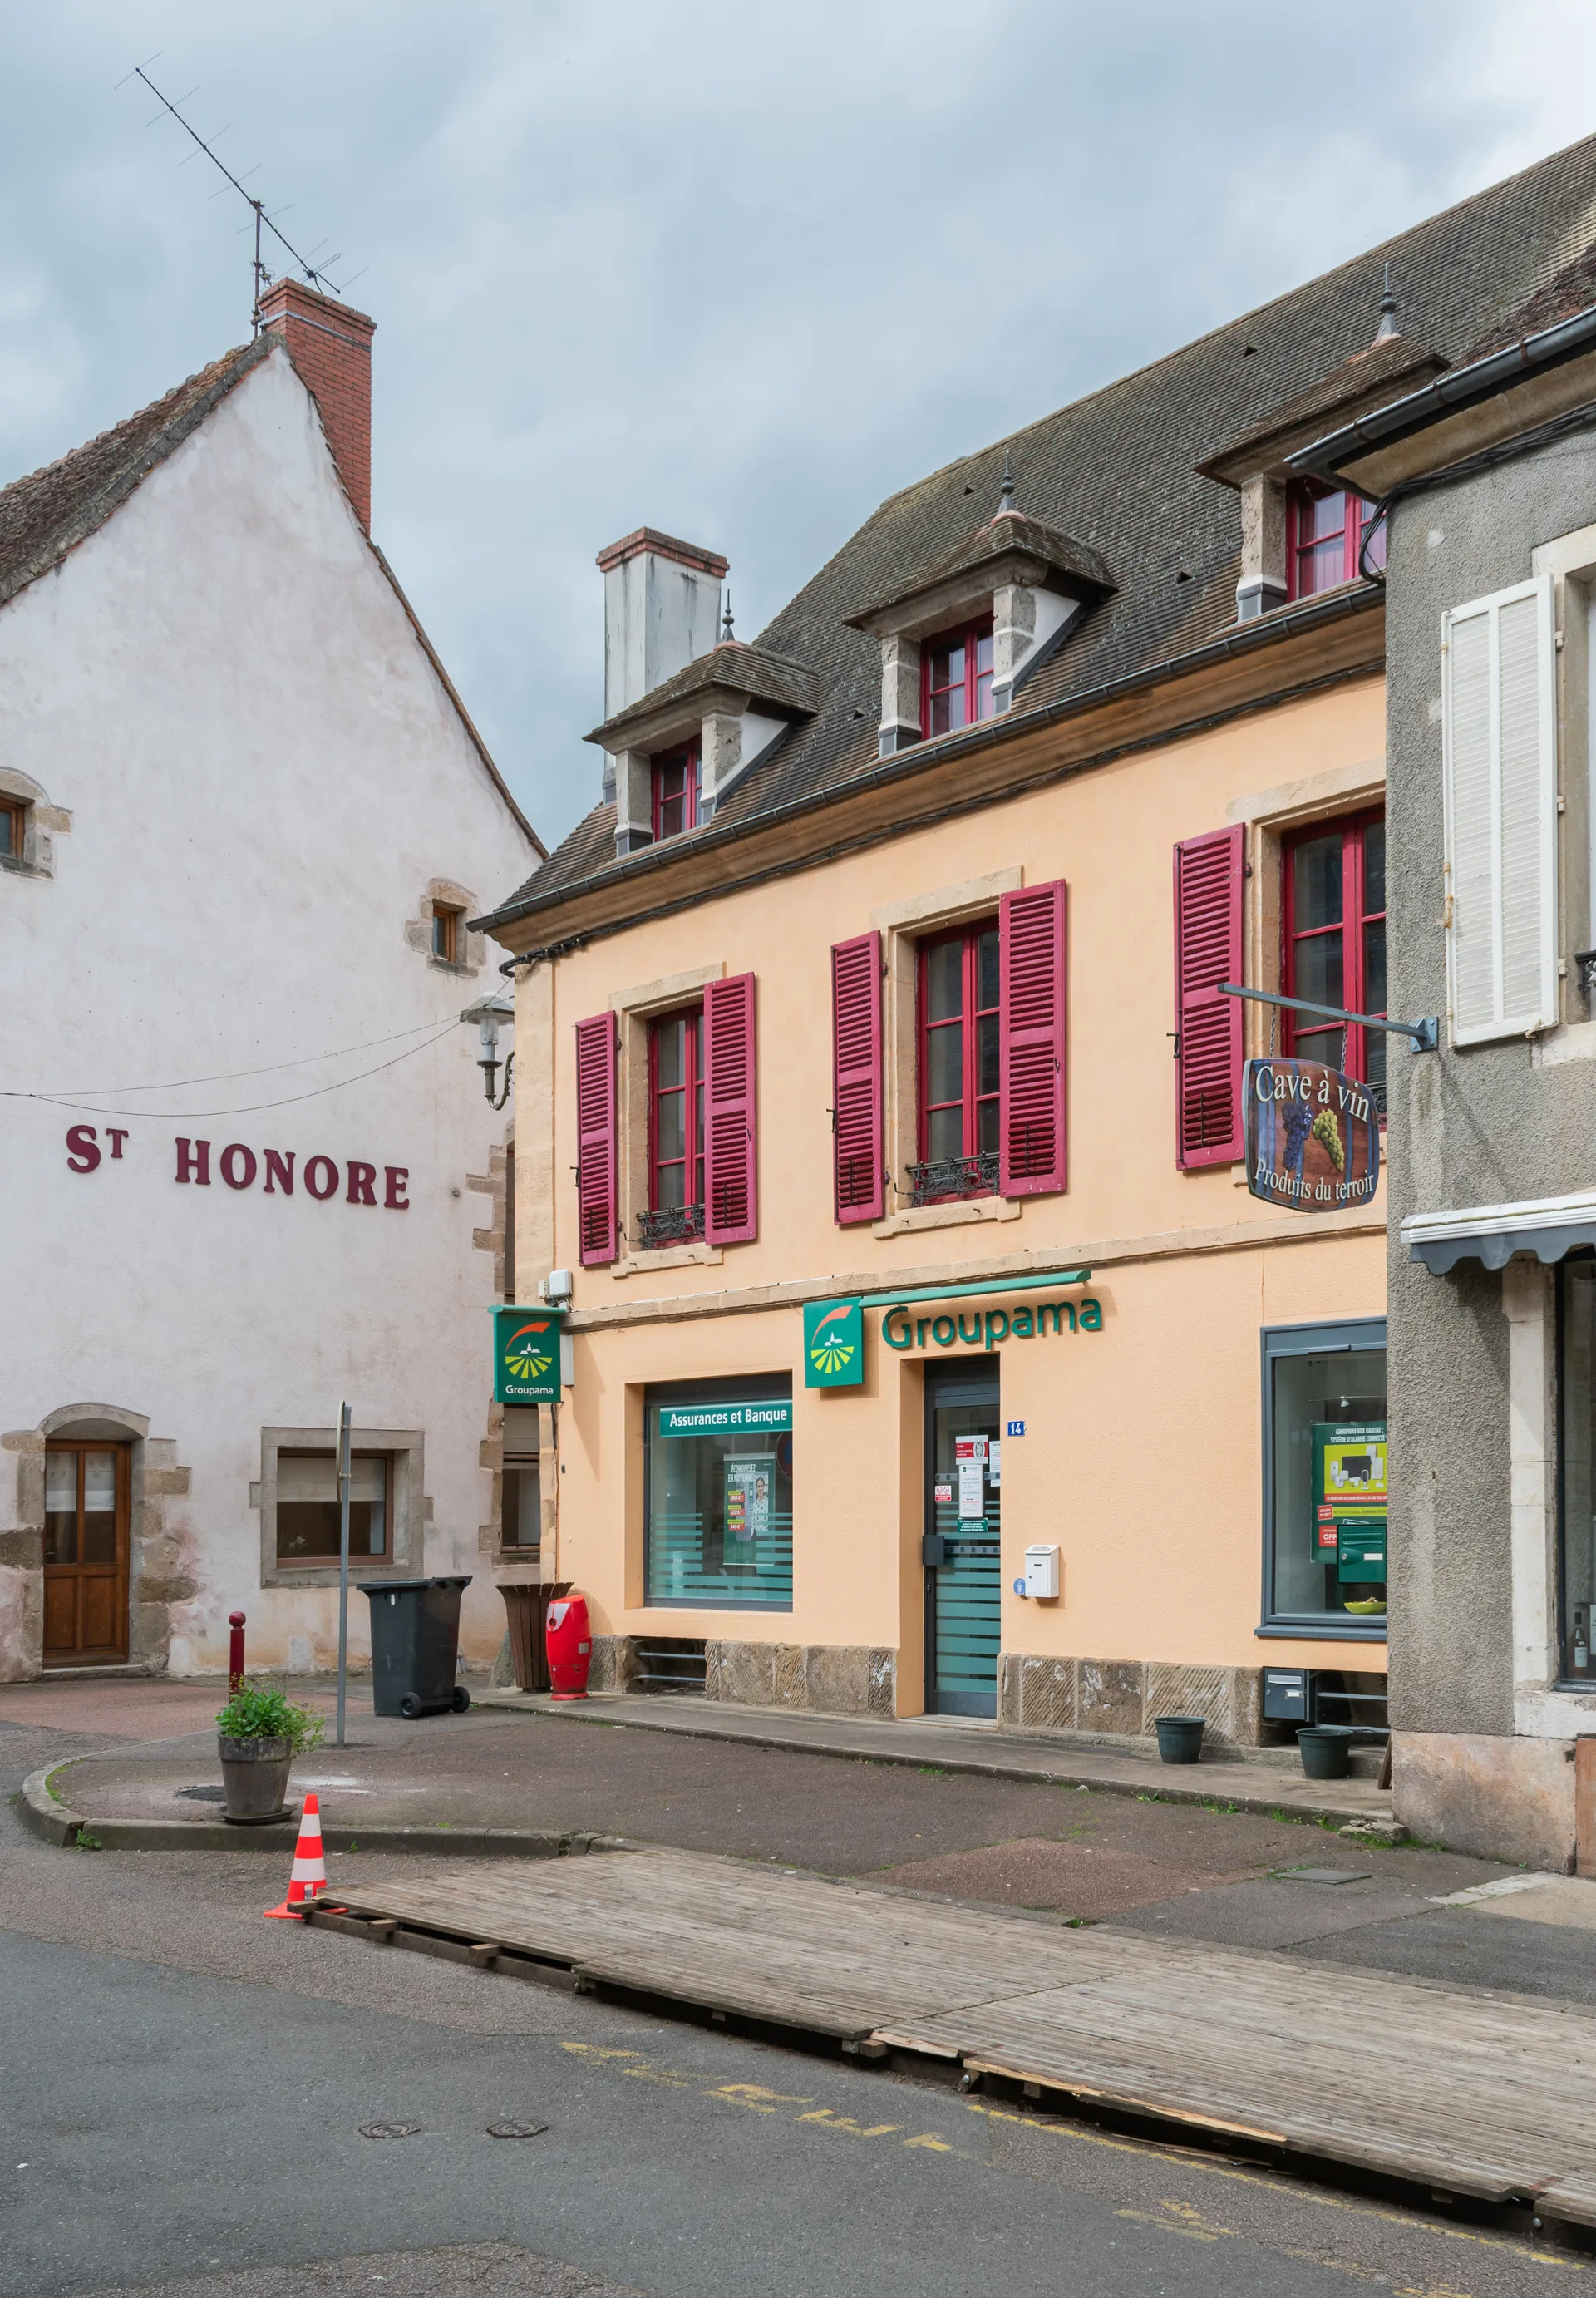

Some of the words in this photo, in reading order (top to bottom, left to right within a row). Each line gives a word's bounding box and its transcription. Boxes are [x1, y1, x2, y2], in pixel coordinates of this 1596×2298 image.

[1255, 1065, 1312, 1102] Cave
[1318, 1070, 1329, 1104] à
[1337, 1082, 1370, 1122] vin
[175, 1137, 410, 1209] HONORE
[1254, 1158, 1311, 1199] Produits
[1314, 1176, 1332, 1201] du
[1335, 1169, 1374, 1200] terroir
[882, 1298, 1101, 1350] Groupama
[505, 1384, 554, 1396] Groupama
[669, 1413, 728, 1428] Assurances
[731, 1411, 742, 1423] et
[745, 1408, 787, 1425] Banque
[1010, 1423, 1022, 1435] 14
[1330, 1435, 1347, 1443] SYSTÈME
[732, 1463, 756, 1473] ÉCONOMISEZ
[728, 1474, 734, 1482] EN
